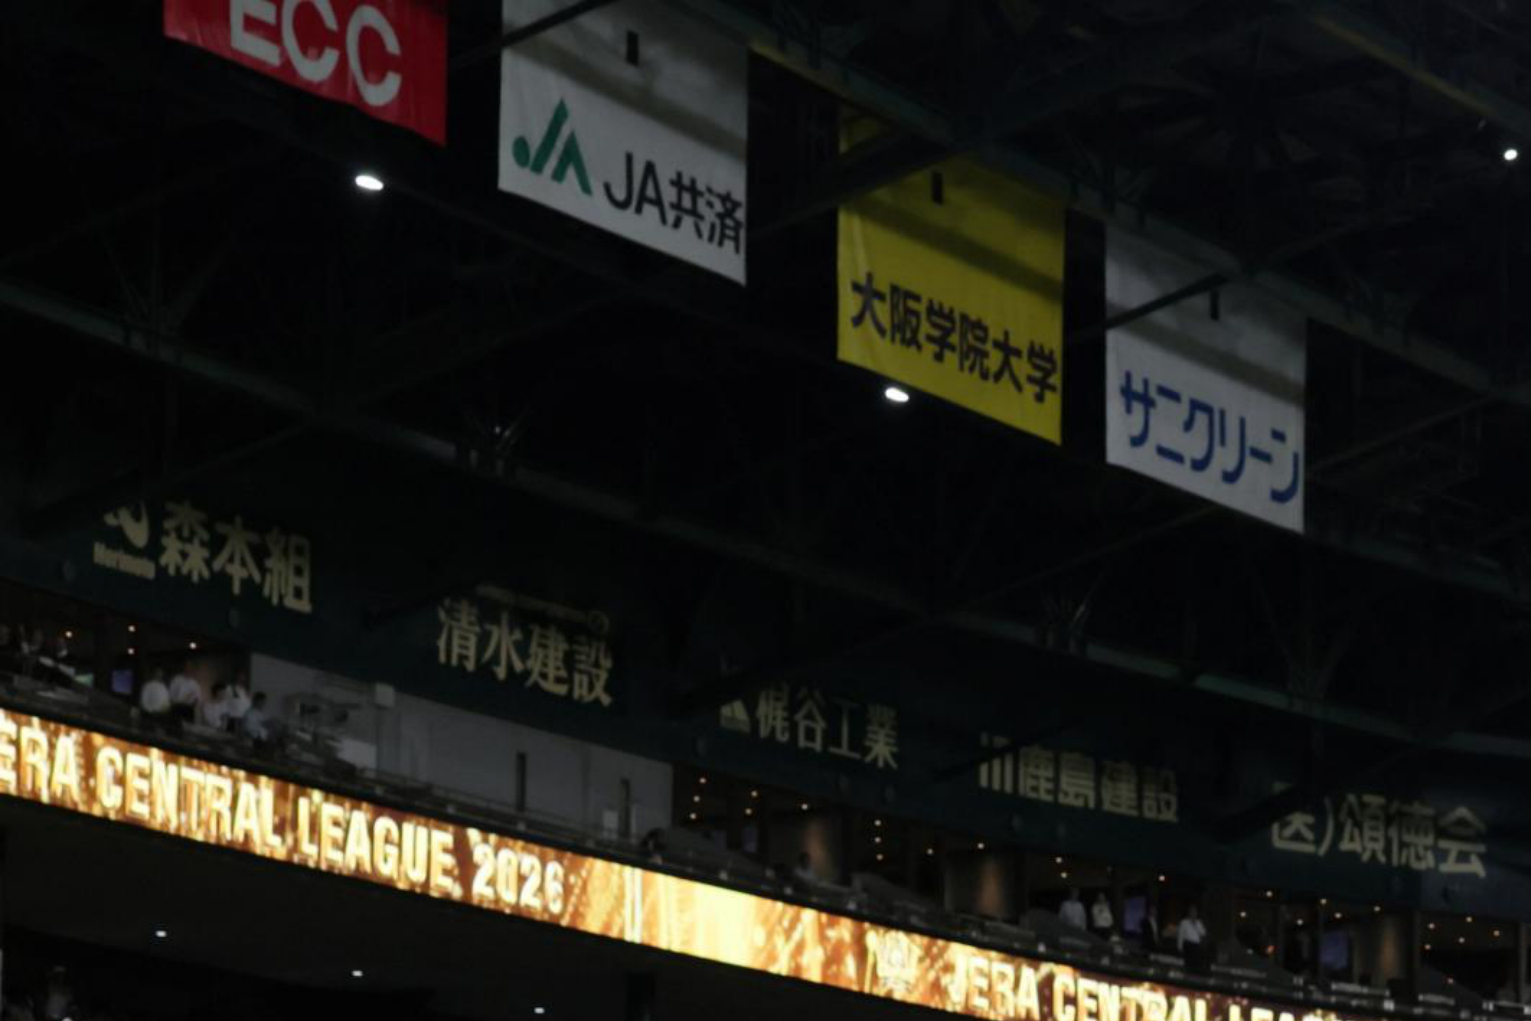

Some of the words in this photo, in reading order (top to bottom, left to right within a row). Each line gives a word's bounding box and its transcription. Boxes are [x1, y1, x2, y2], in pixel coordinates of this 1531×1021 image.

[230, 0, 402, 106] ECC
[604, 151, 743, 254] JA共済
[851, 273, 1058, 403] 大阪学院大学
[1120, 371, 1299, 504] サニクリーン
[158, 500, 313, 614] 森本組
[437, 597, 615, 707] 清水建設
[96, 746, 283, 848] CENTRAL
[299, 793, 458, 892] LEAGUE
[471, 842, 566, 914] 2026
[1018, 743, 1180, 824] 鹿島建設
[949, 955, 1041, 1021] JERA
